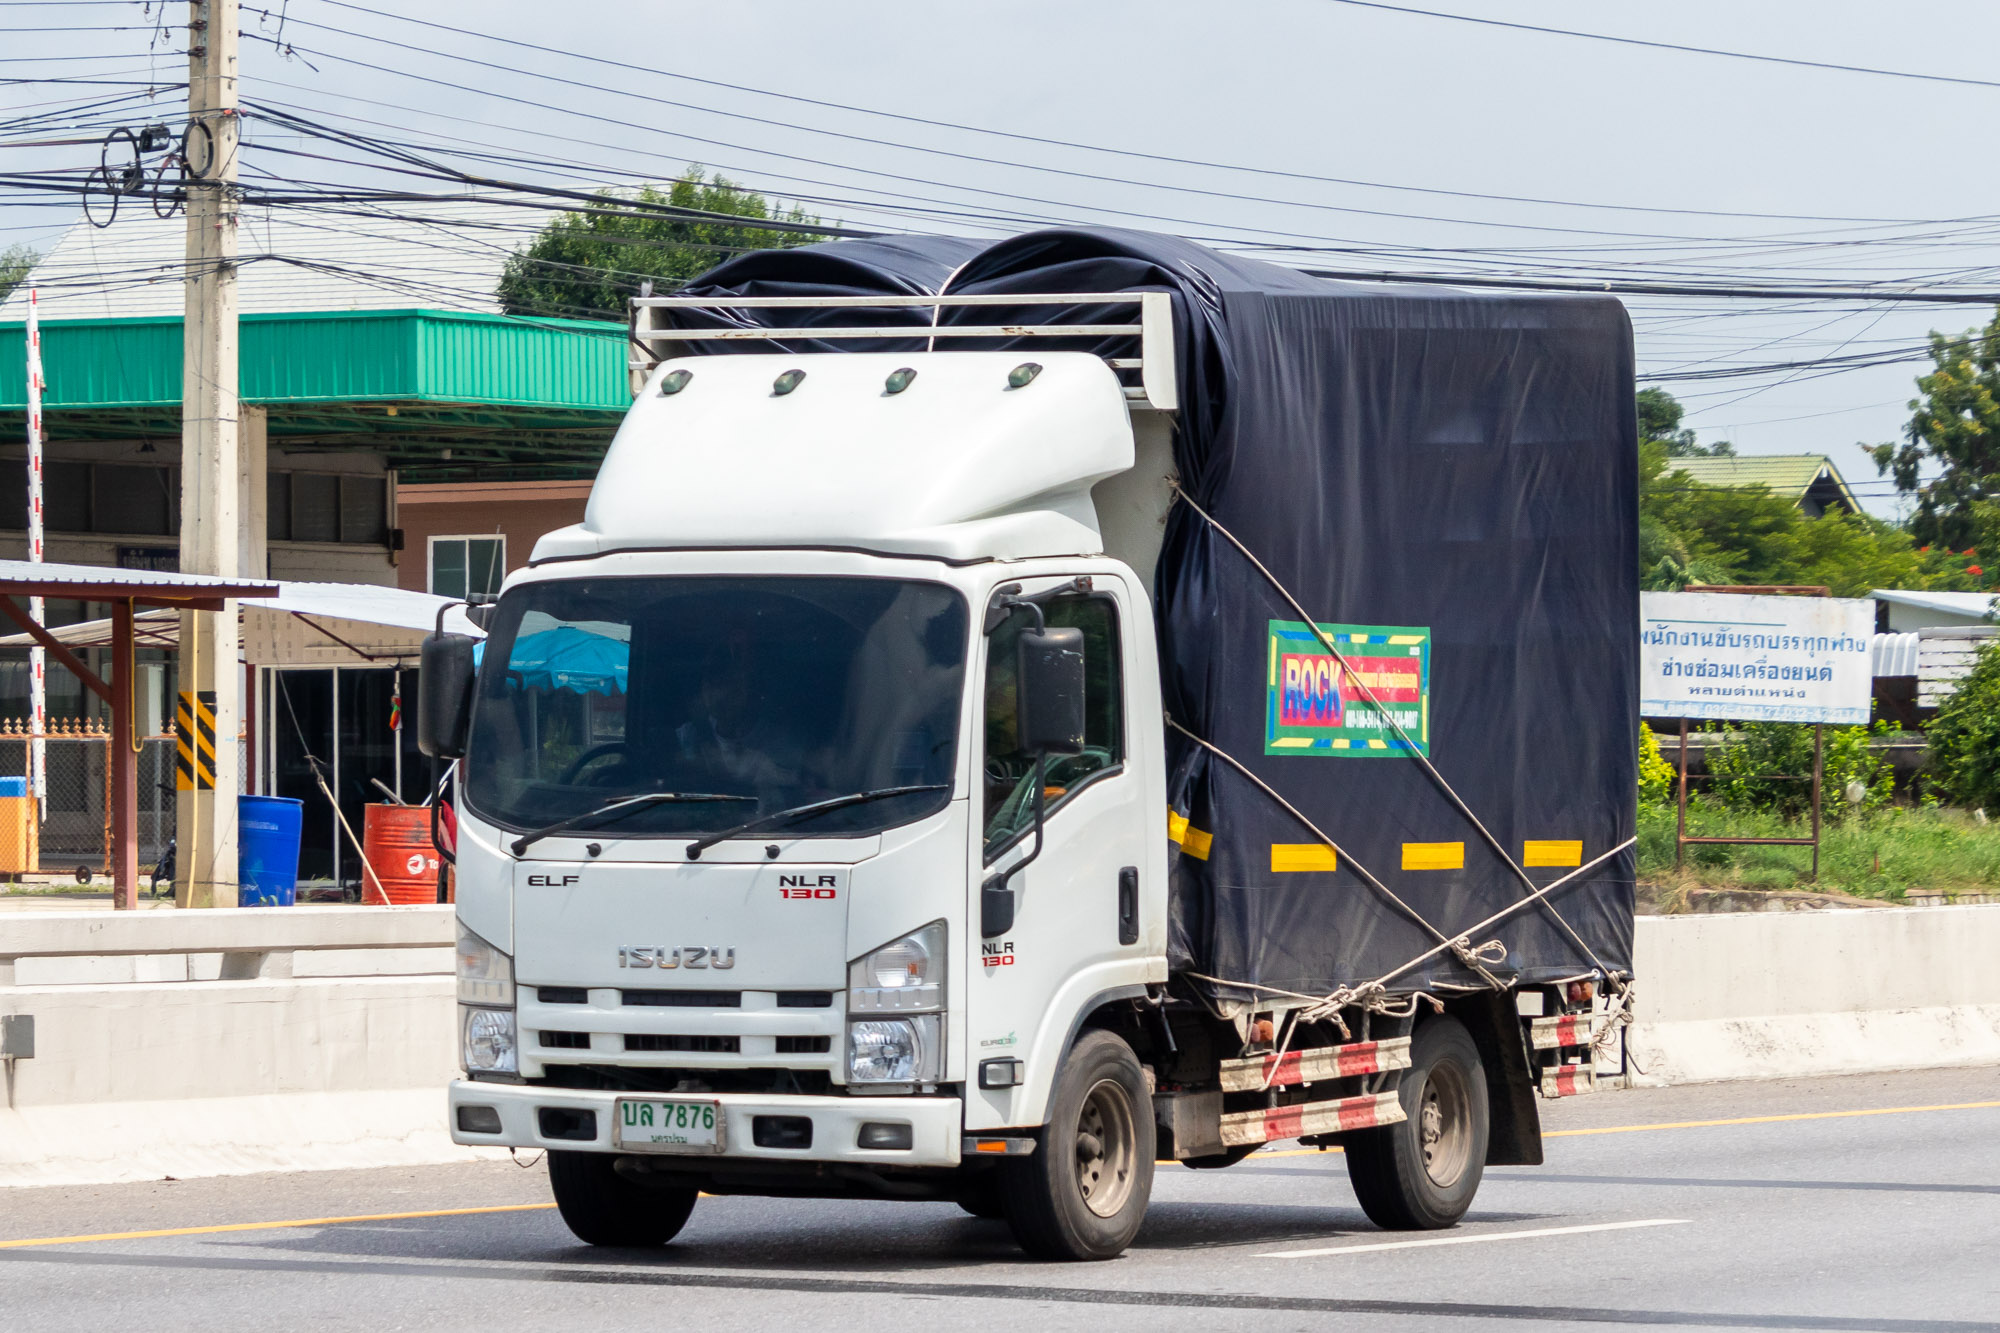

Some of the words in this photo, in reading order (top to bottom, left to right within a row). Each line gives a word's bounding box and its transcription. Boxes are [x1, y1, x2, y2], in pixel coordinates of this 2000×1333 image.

[1283, 658, 1342, 717] ROCK
[1689, 685, 1806, 699] หลายตำแหน่ง
[527, 875, 580, 887] ELF
[779, 875, 837, 887] NLR
[779, 889, 836, 899] 130
[981, 942, 1015, 955] NLR
[617, 944, 736, 970] ISUZU
[981, 955, 1015, 967] 130
[622, 1102, 654, 1128] บล
[662, 1103, 715, 1130] 7876
